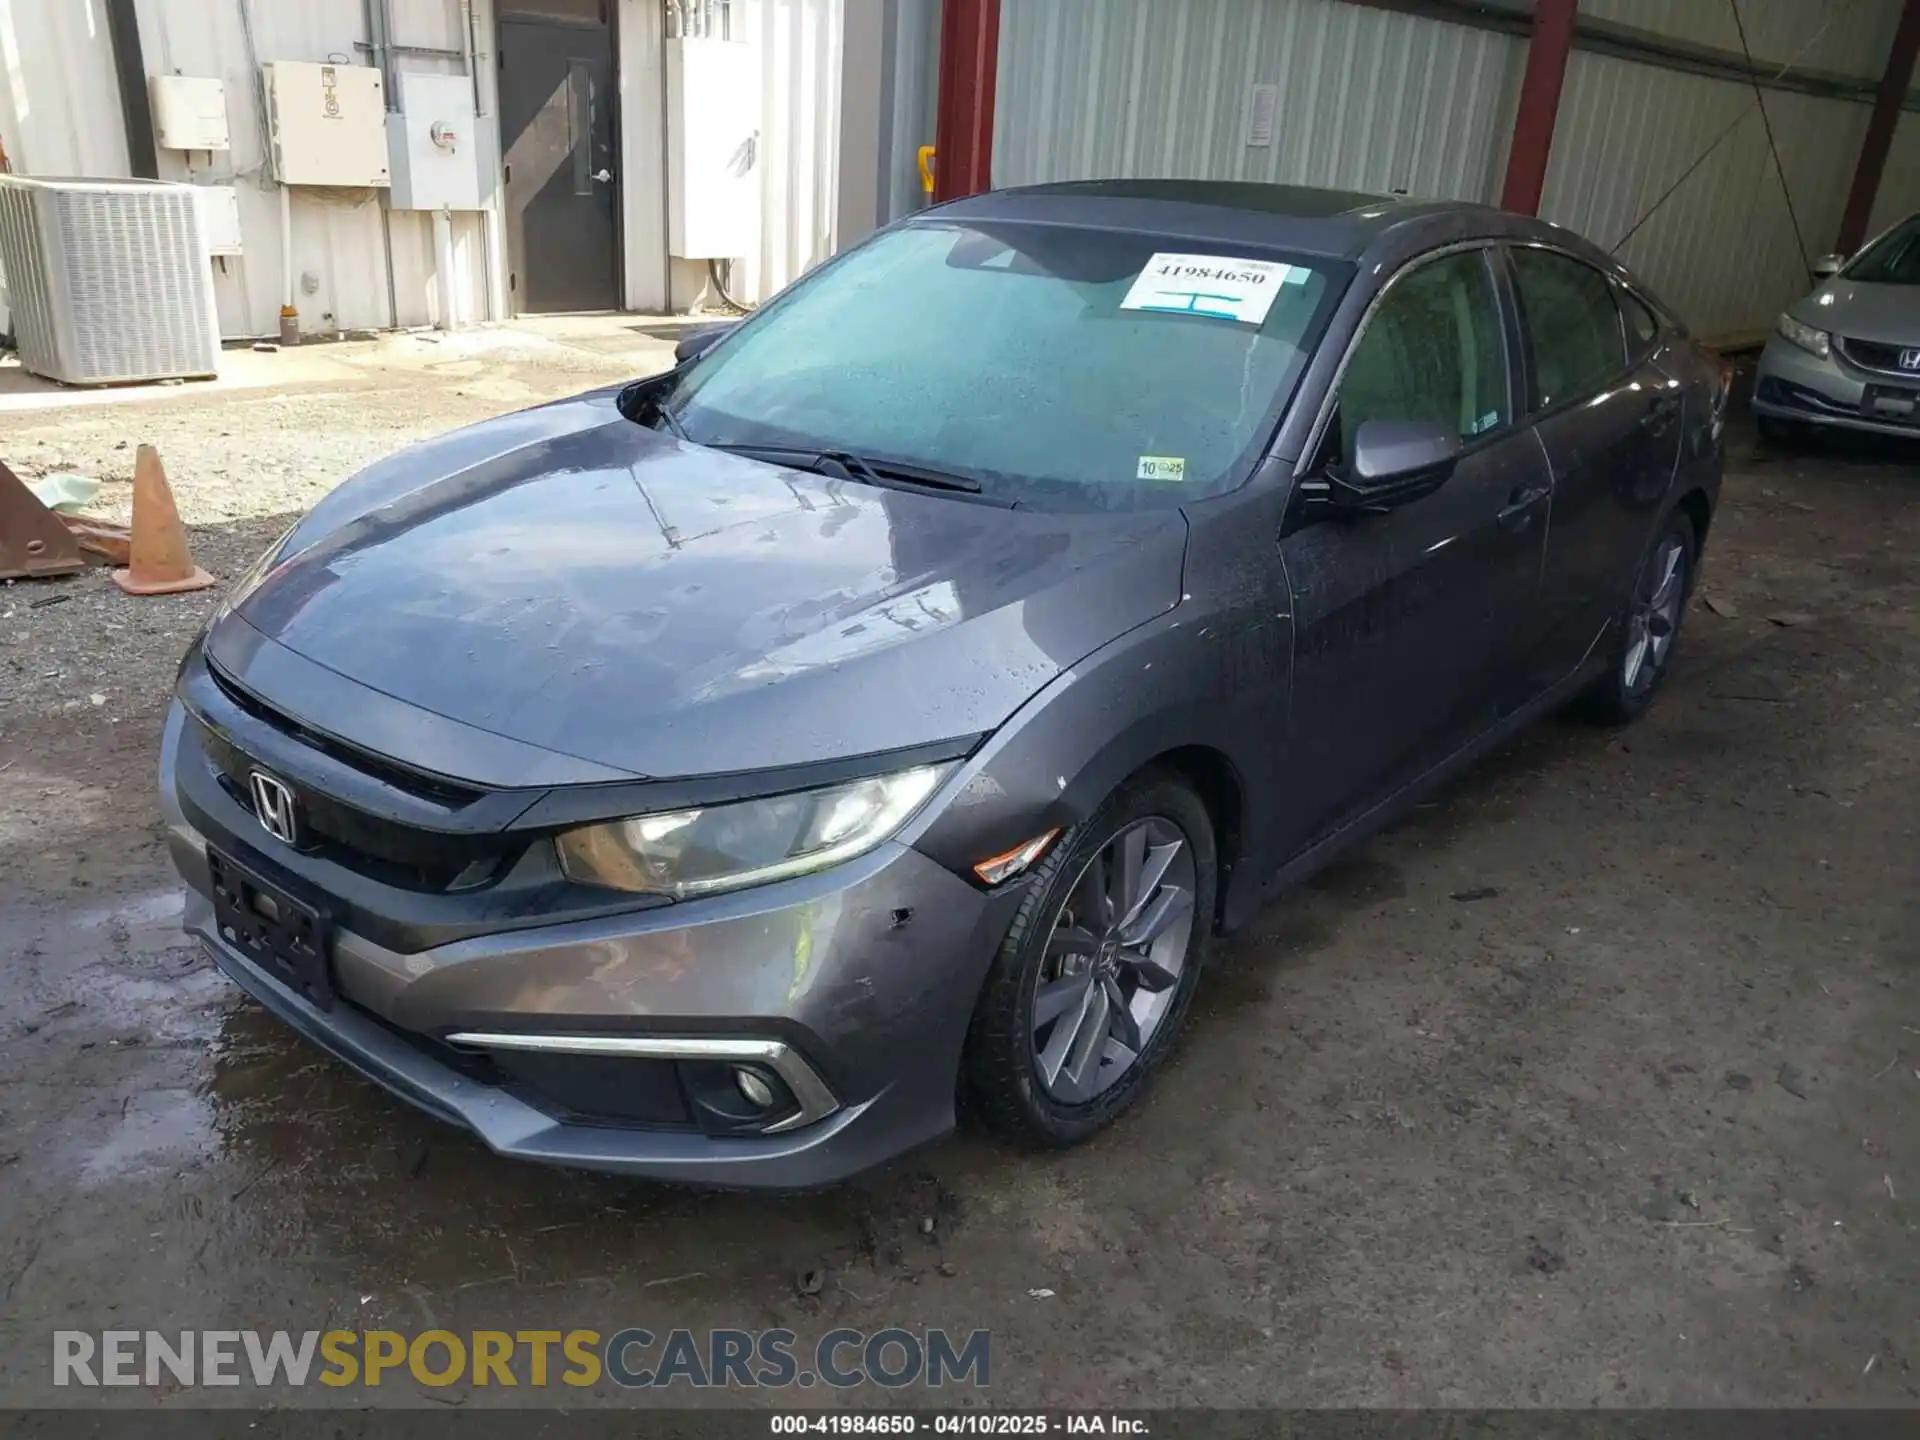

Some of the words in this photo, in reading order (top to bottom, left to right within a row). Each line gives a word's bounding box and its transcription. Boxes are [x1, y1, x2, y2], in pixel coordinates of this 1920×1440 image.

[1157, 265, 1266, 285] 41984650
[1142, 462, 1156, 475] 10
[1169, 463, 1182, 473] 25
